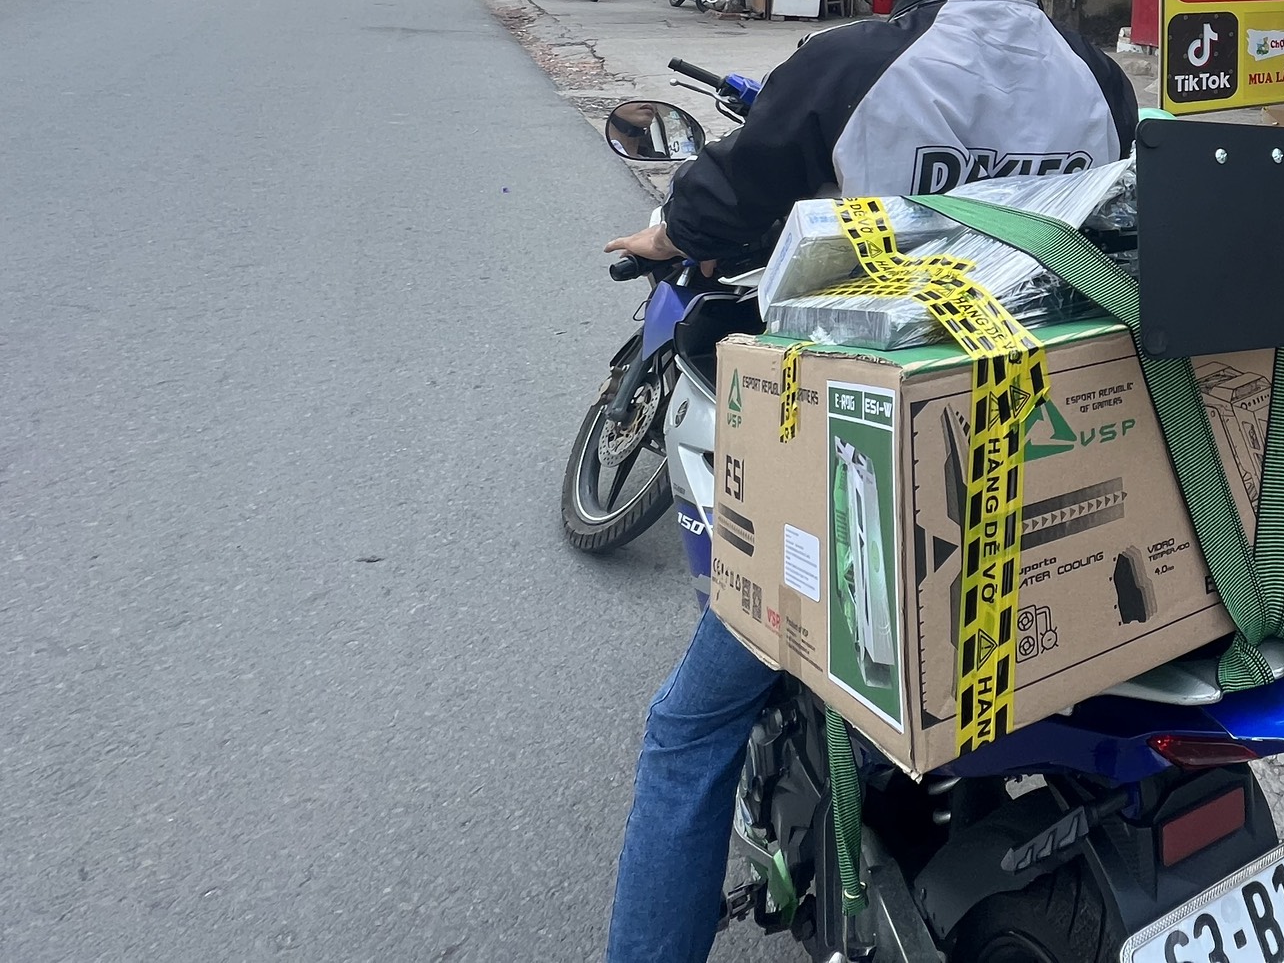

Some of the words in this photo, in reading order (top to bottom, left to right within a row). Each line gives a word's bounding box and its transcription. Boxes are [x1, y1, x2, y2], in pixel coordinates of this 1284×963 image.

[1174, 70, 1232, 93] TikTok
[1248, 72, 1274, 86] MUA
[1065, 391, 1096, 405] ESPORT
[1098, 382, 1134, 398] REPUBLIC
[1080, 404, 1090, 413] OF
[1092, 396, 1123, 411] GAMERS
[727, 412, 742, 428] VSP
[1080, 418, 1136, 447] VSP
[678, 511, 706, 535] 150
[1147, 538, 1175, 554] VIDRO
[1148, 541, 1190, 563] TEMPERADO
[1018, 570, 1051, 589] ATER
[1057, 551, 1105, 576] COOLING
